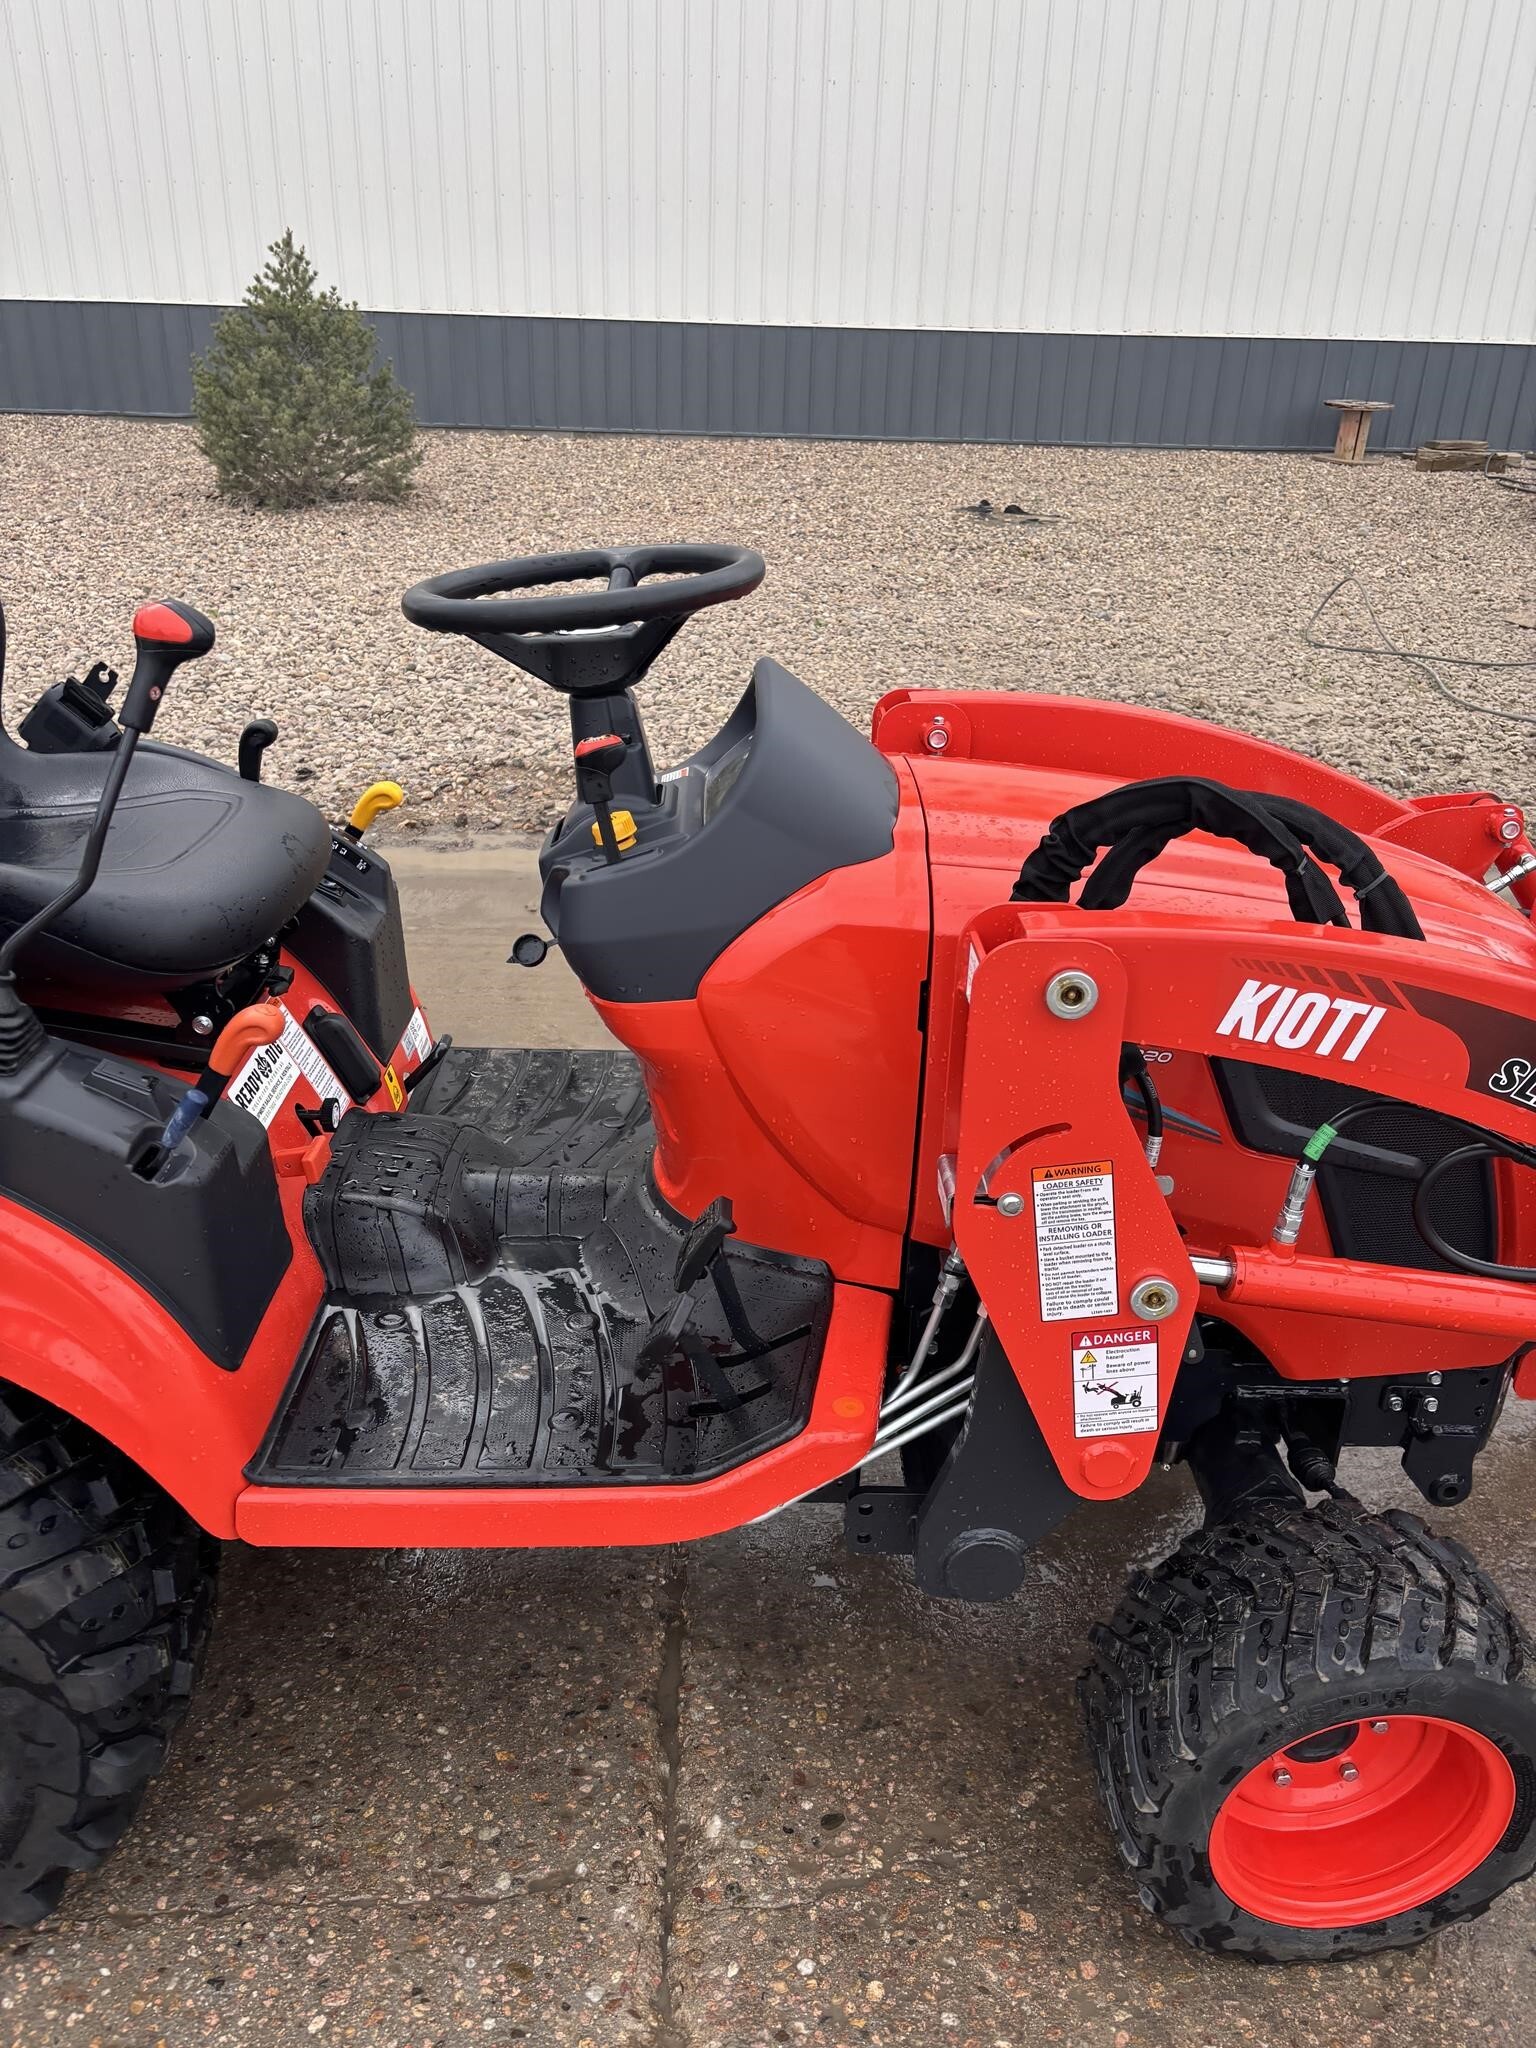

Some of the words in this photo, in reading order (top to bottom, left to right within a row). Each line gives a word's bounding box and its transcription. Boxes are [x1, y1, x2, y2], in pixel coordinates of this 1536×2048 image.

[1216, 979, 1387, 1062] KIOTI
[1140, 1049, 1173, 1063] 20
[235, 1068, 263, 1109] READY
[1054, 1165, 1102, 1177] WARNING
[1042, 1181, 1074, 1190] LOADER
[1076, 1178, 1104, 1187] SAFETY
[1039, 1233, 1080, 1242] INSTALLING
[1082, 1229, 1112, 1238] LOADER
[1048, 1224, 1089, 1234] REMOVING
[1094, 1330, 1151, 1345] DANGER
